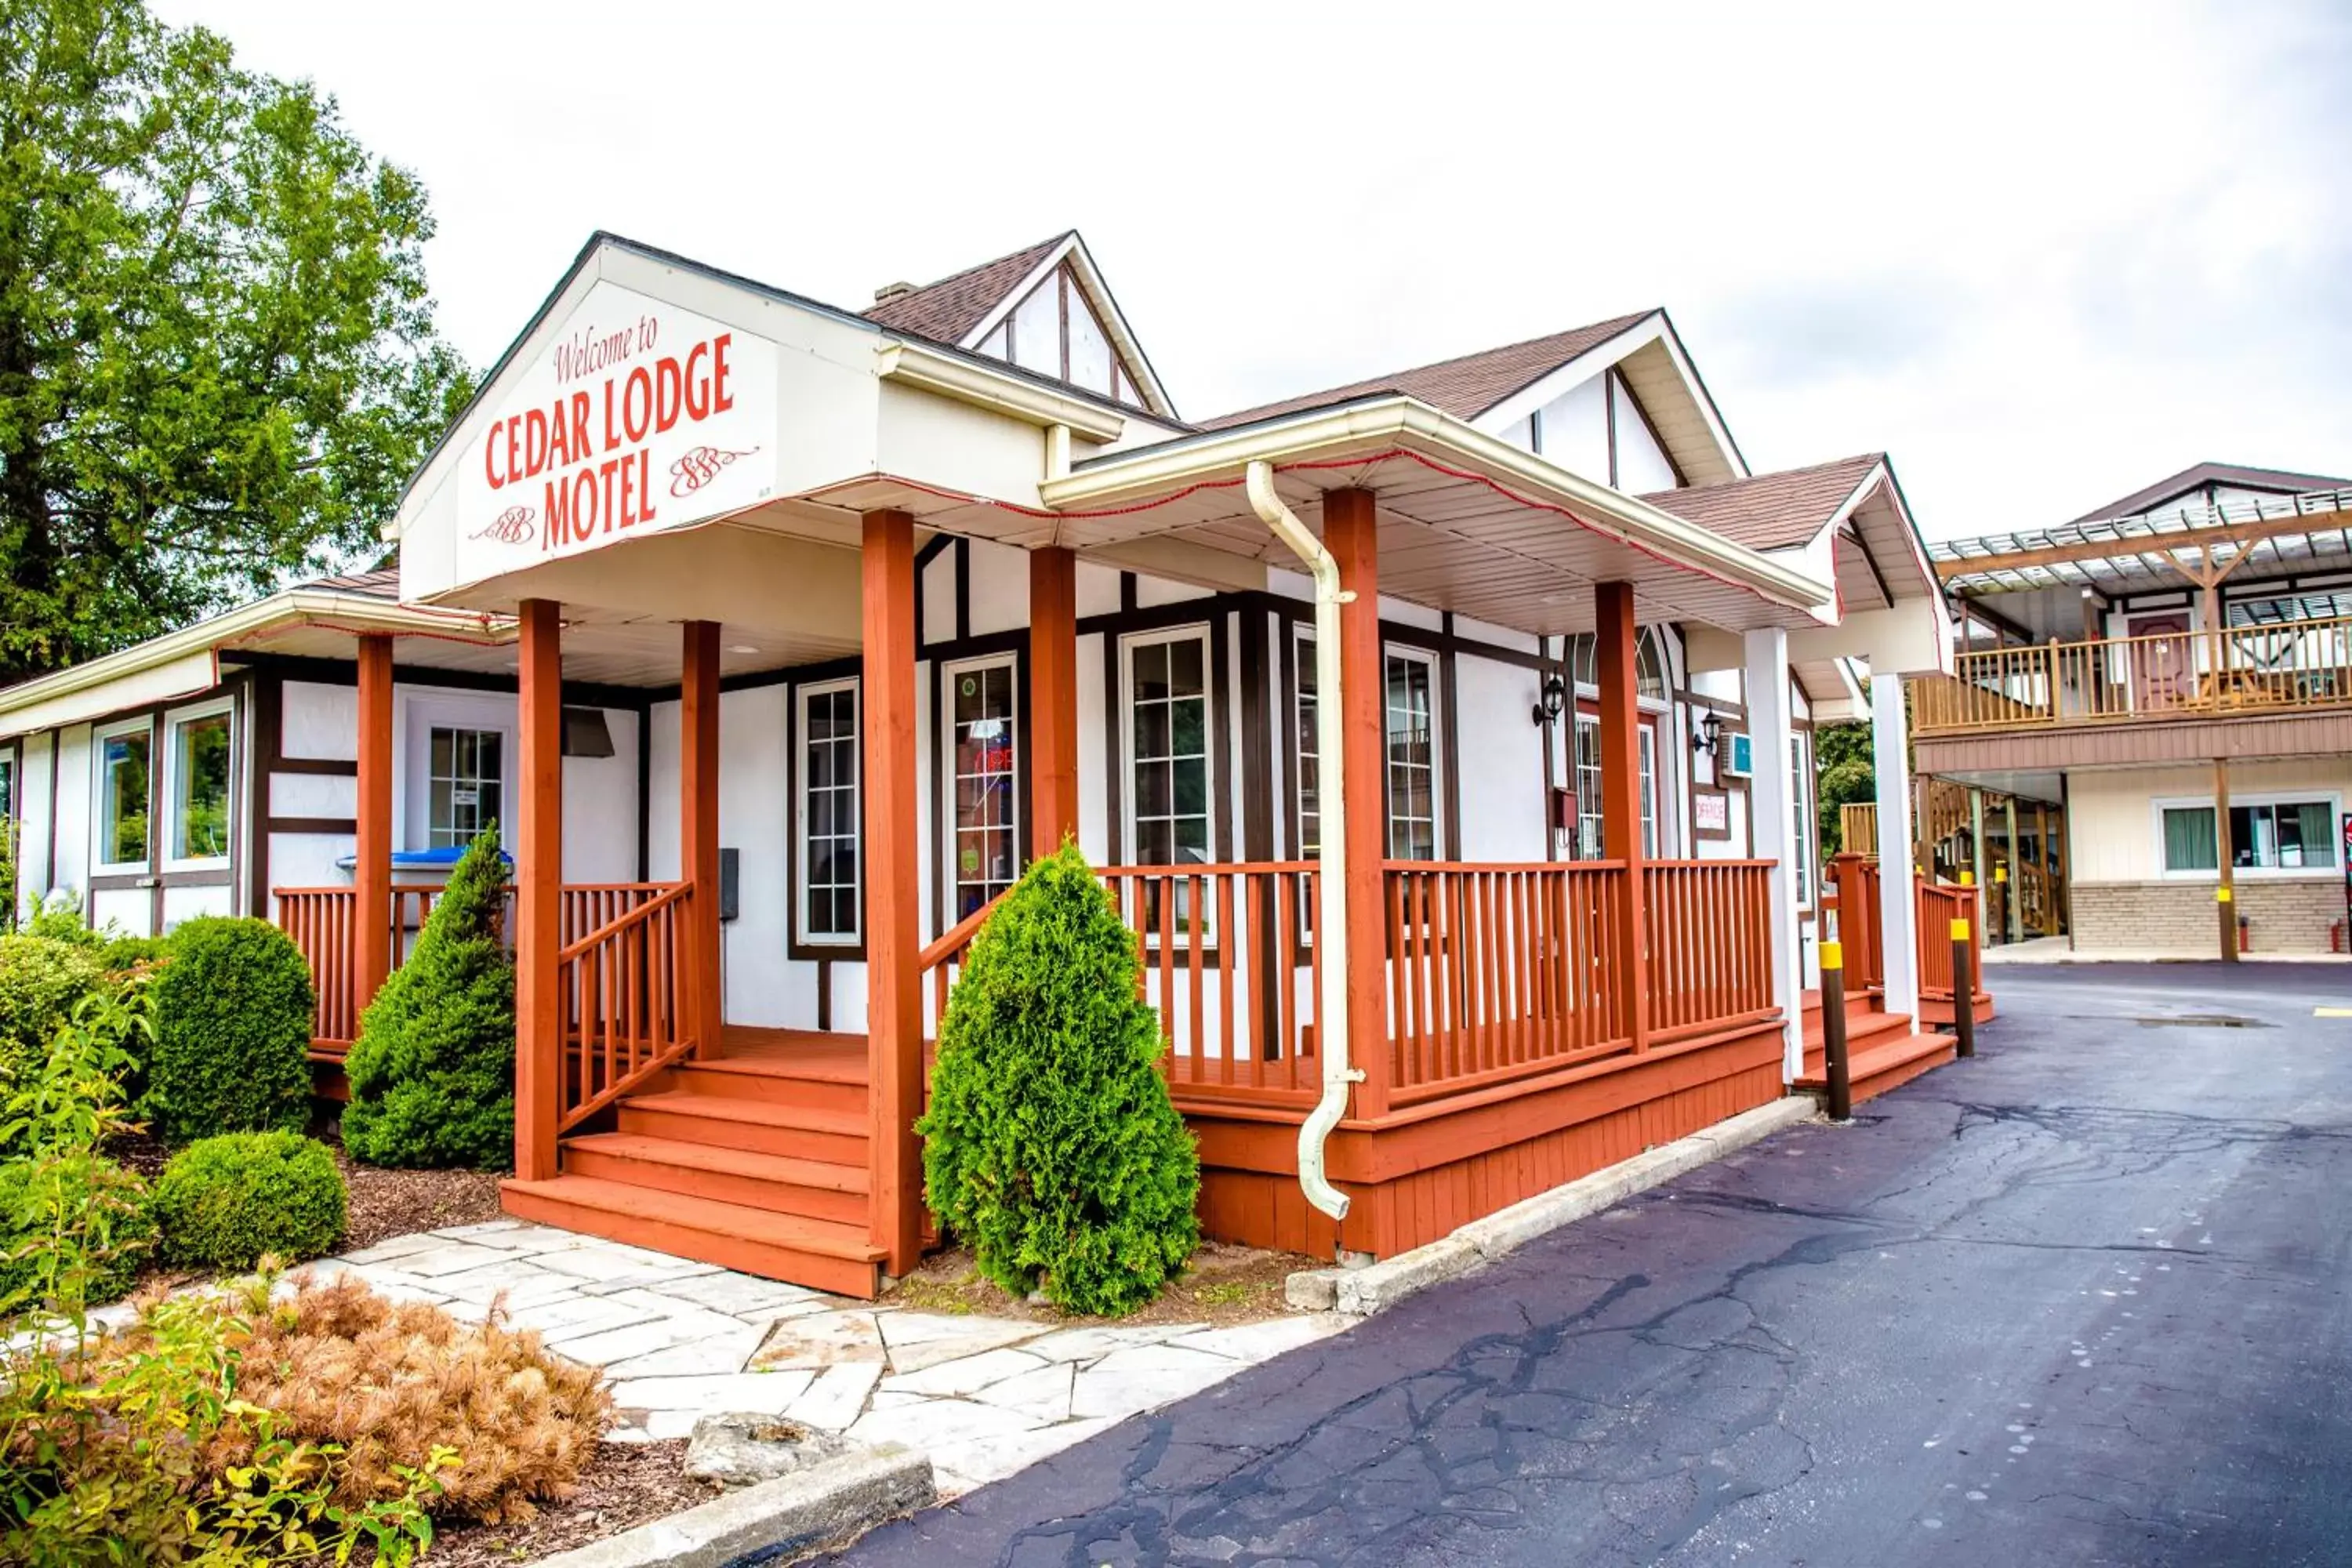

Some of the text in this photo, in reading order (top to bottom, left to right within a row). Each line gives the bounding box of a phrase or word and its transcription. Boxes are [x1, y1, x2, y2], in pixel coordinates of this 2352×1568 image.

[554, 314, 658, 384] Welcome to
[485, 332, 734, 490] CEDAR LODGE
[543, 448, 657, 550] MOTEL
